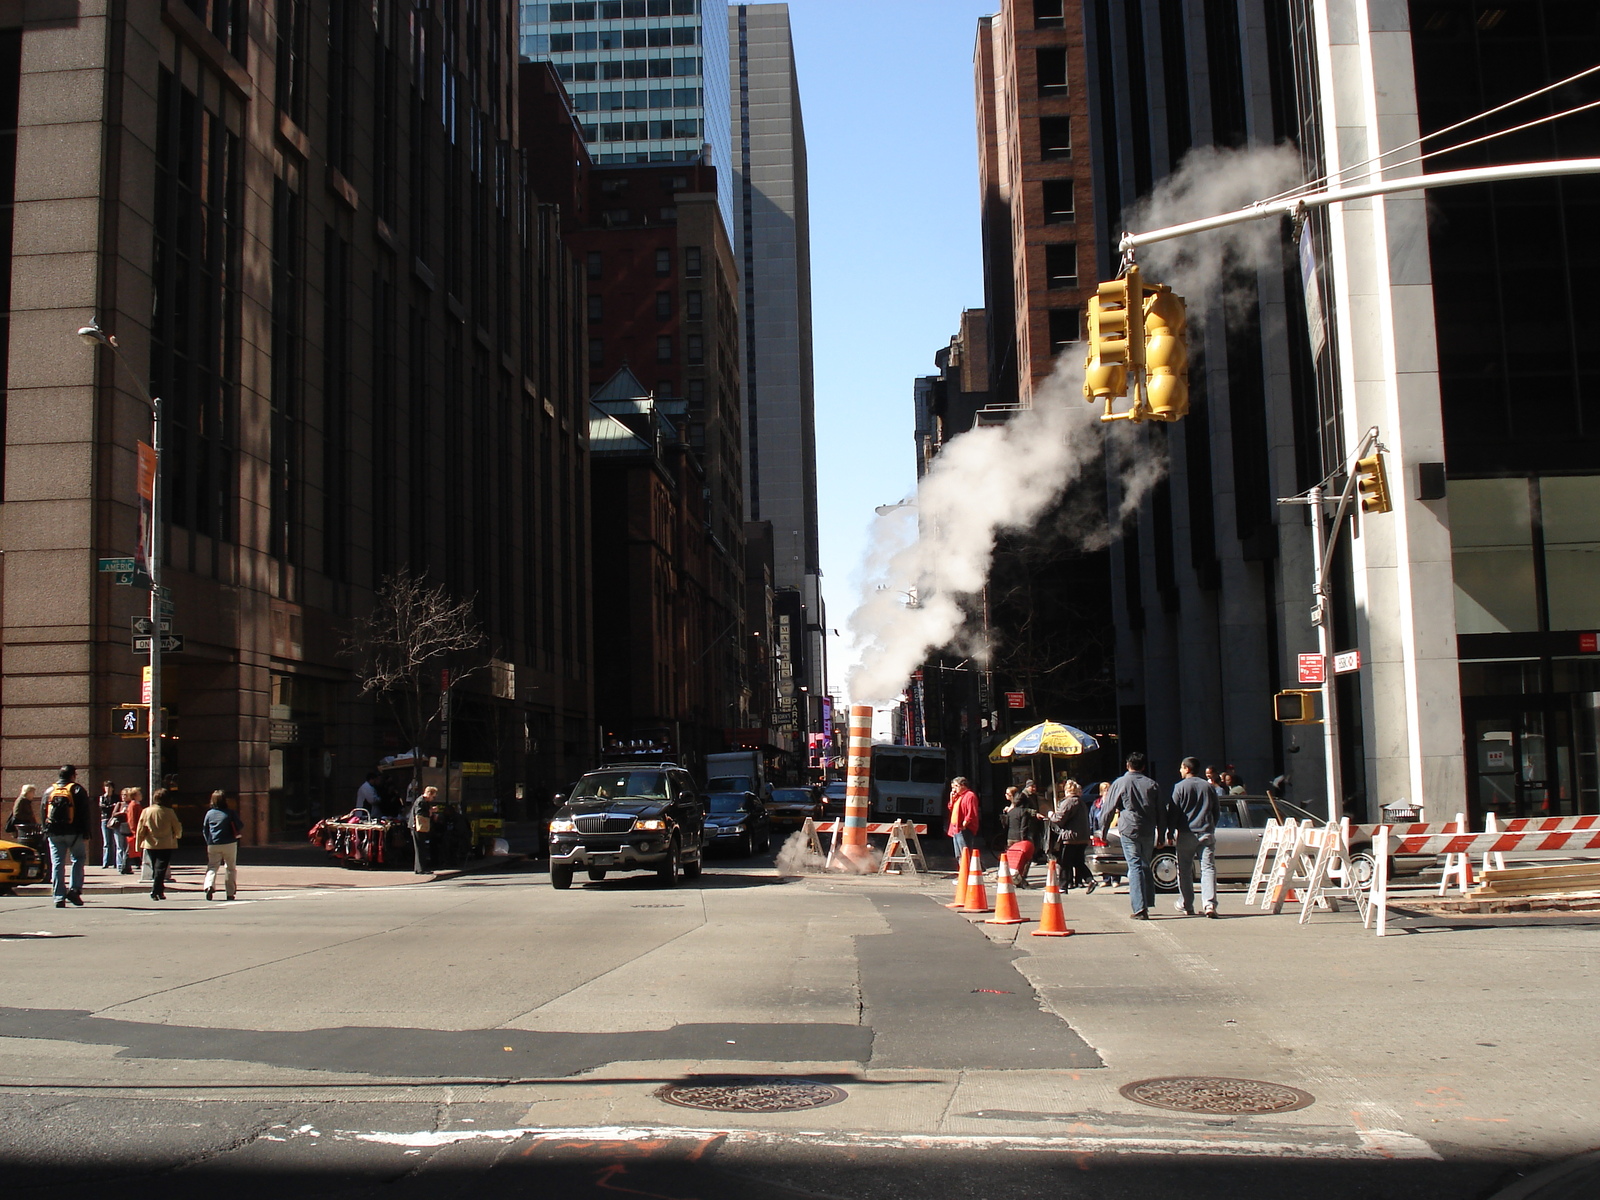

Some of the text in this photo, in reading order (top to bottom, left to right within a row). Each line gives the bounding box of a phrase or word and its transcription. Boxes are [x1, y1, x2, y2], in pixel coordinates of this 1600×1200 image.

[104, 562, 134, 571] AMERIC
[120, 573, 129, 583] 6
[160, 640, 176, 648] WAY
